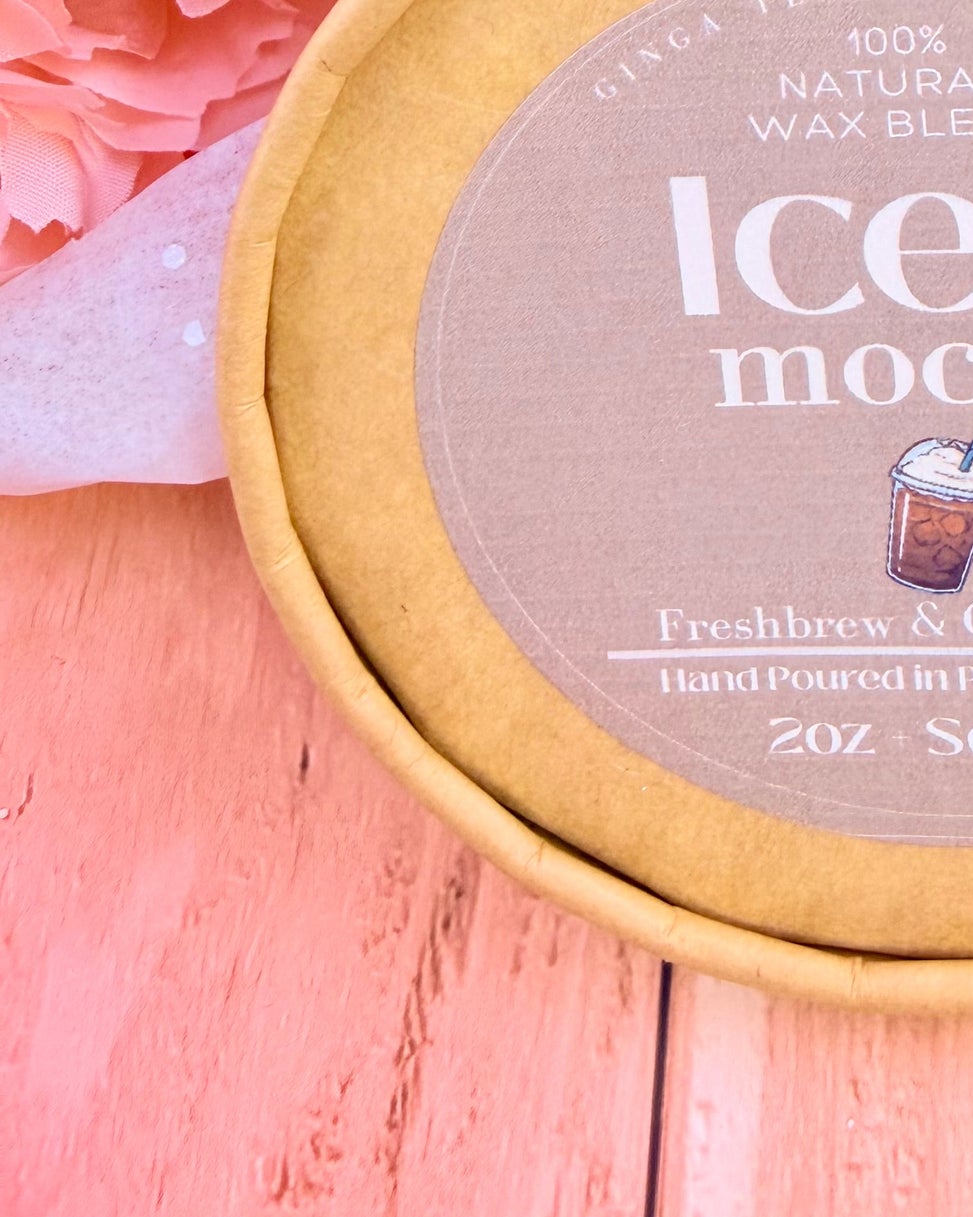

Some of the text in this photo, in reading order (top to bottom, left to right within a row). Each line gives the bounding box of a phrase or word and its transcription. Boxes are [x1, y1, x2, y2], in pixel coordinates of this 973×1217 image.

[593, 12, 721, 101] GINGA
[848, 25, 947, 56] 100%
[748, 110, 867, 142] WAX
[656, 605, 895, 642] Freshbrew
[911, 602, 946, 638] &
[660, 667, 758, 694] Hand
[768, 666, 906, 692] Poured
[914, 664, 951, 691] in
[768, 717, 876, 756] 2oz
